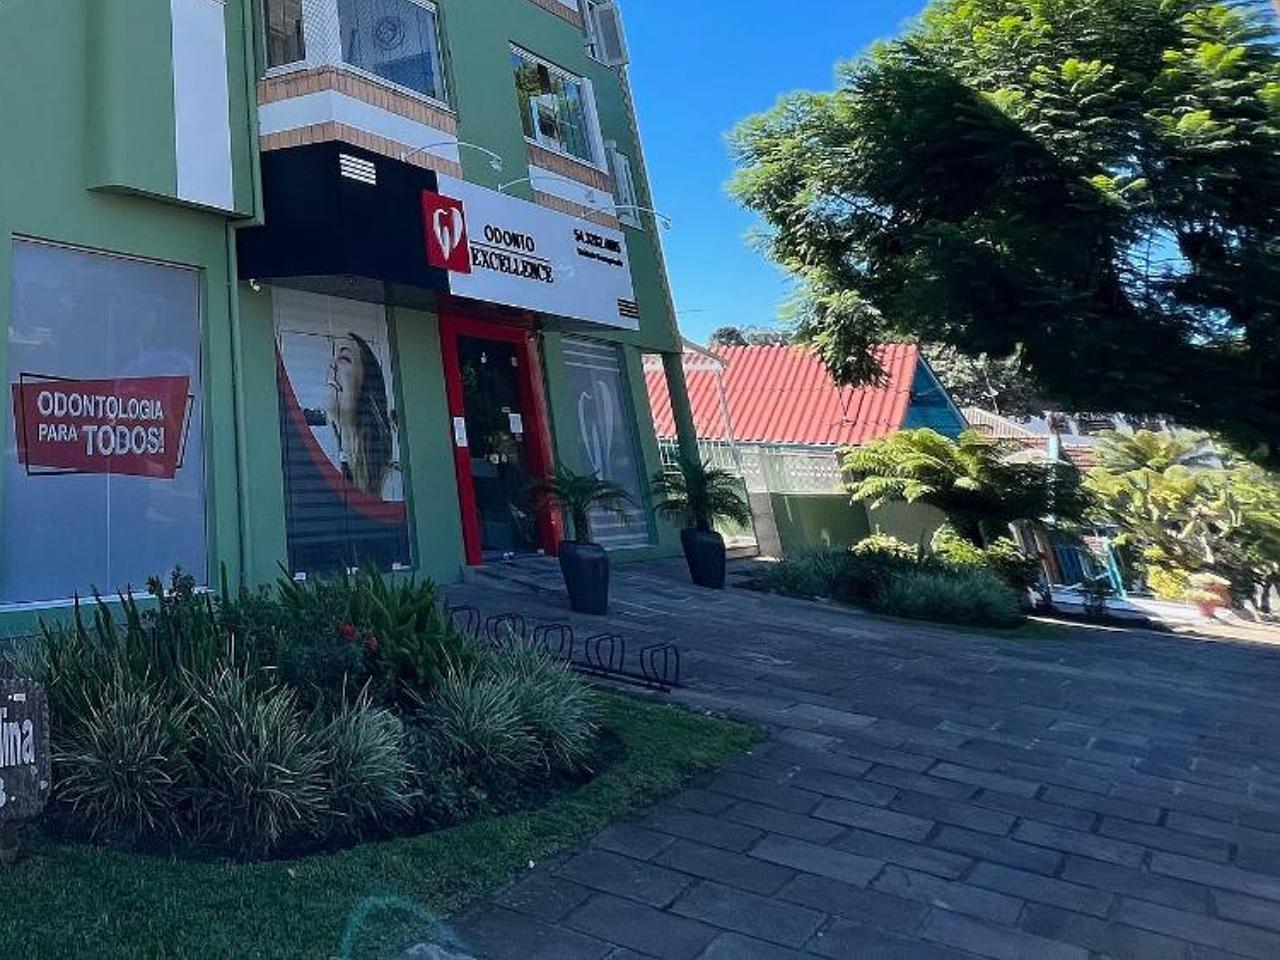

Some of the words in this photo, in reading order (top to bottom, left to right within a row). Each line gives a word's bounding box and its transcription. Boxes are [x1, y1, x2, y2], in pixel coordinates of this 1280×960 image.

[484, 224, 535, 252] ODONTO
[470, 246, 554, 283] EXCELLENCE
[37, 391, 165, 421] ODONTOLOGIA
[38, 423, 78, 442] PARA
[81, 425, 166, 456] TODOS!
